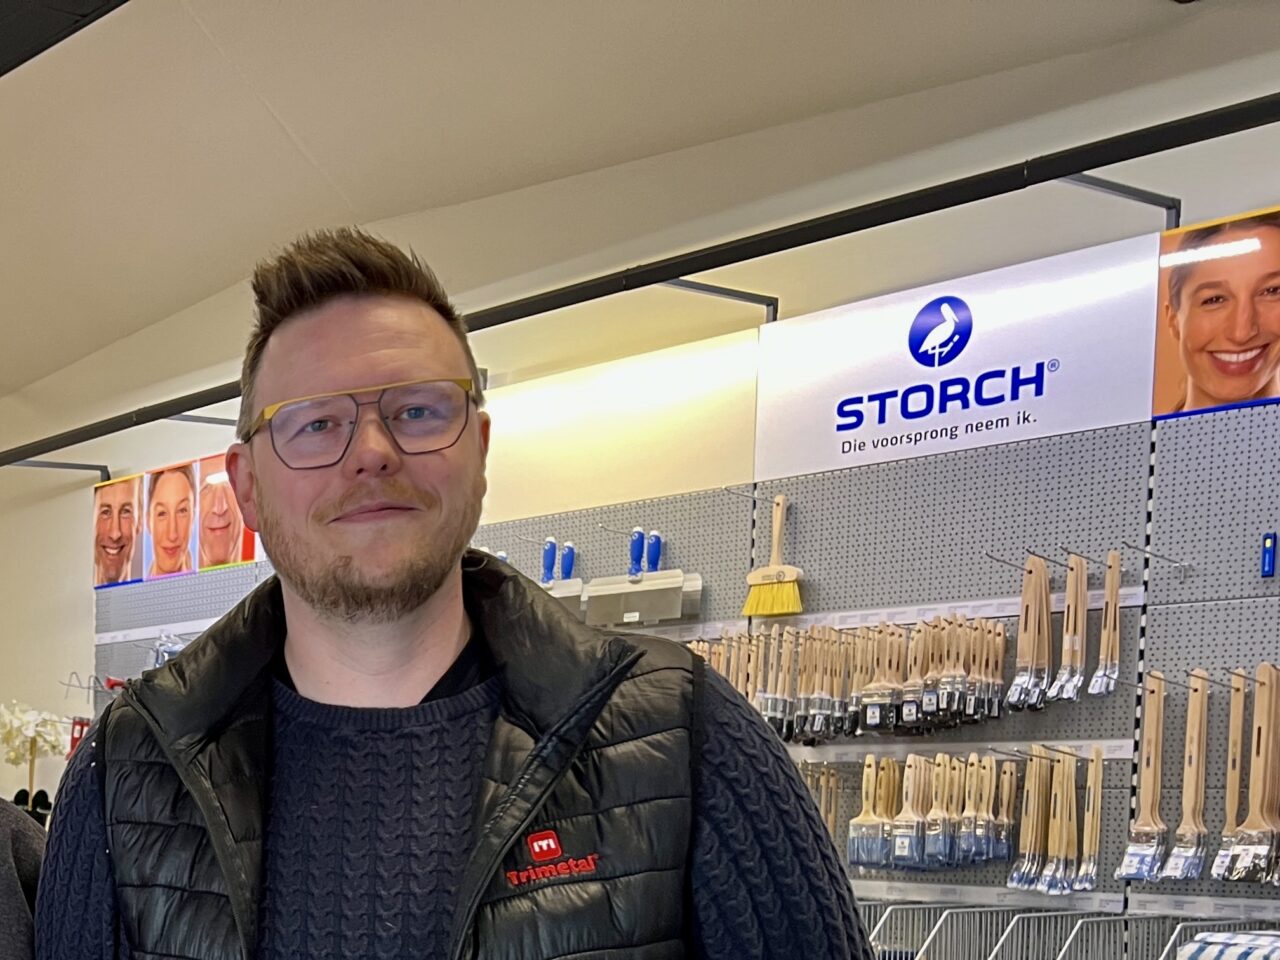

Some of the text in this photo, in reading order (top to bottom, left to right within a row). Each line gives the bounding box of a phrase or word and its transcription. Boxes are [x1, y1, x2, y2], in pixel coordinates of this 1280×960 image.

[841, 410, 1038, 454] Die voorsprong neem ik.
[507, 855, 596, 886] Trimetal
